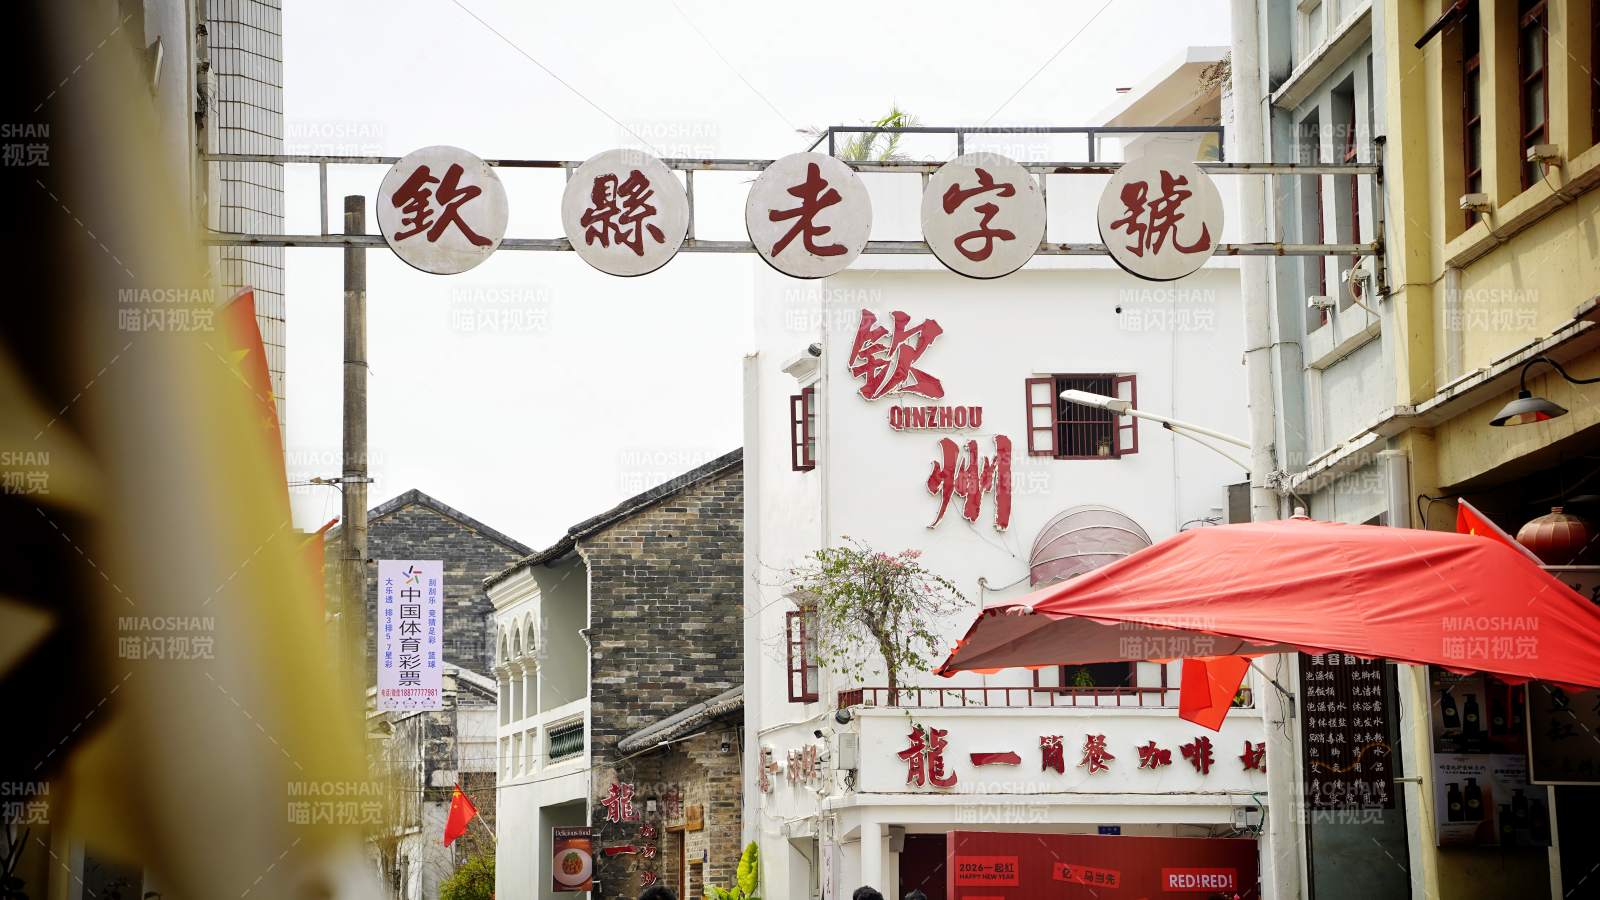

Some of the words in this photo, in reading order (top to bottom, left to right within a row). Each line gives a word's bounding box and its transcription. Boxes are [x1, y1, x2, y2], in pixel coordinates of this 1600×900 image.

[889, 405, 983, 430] QINZHOU
[927, 434, 1013, 530] 州
[398, 586, 422, 686] 中国体育彩票
[1352, 700, 1382, 712] 沐浴露
[1353, 716, 1384, 727] 洗发水
[1137, 735, 1215, 775] 咖啡
[1169, 873, 1233, 888] RED!RED!
